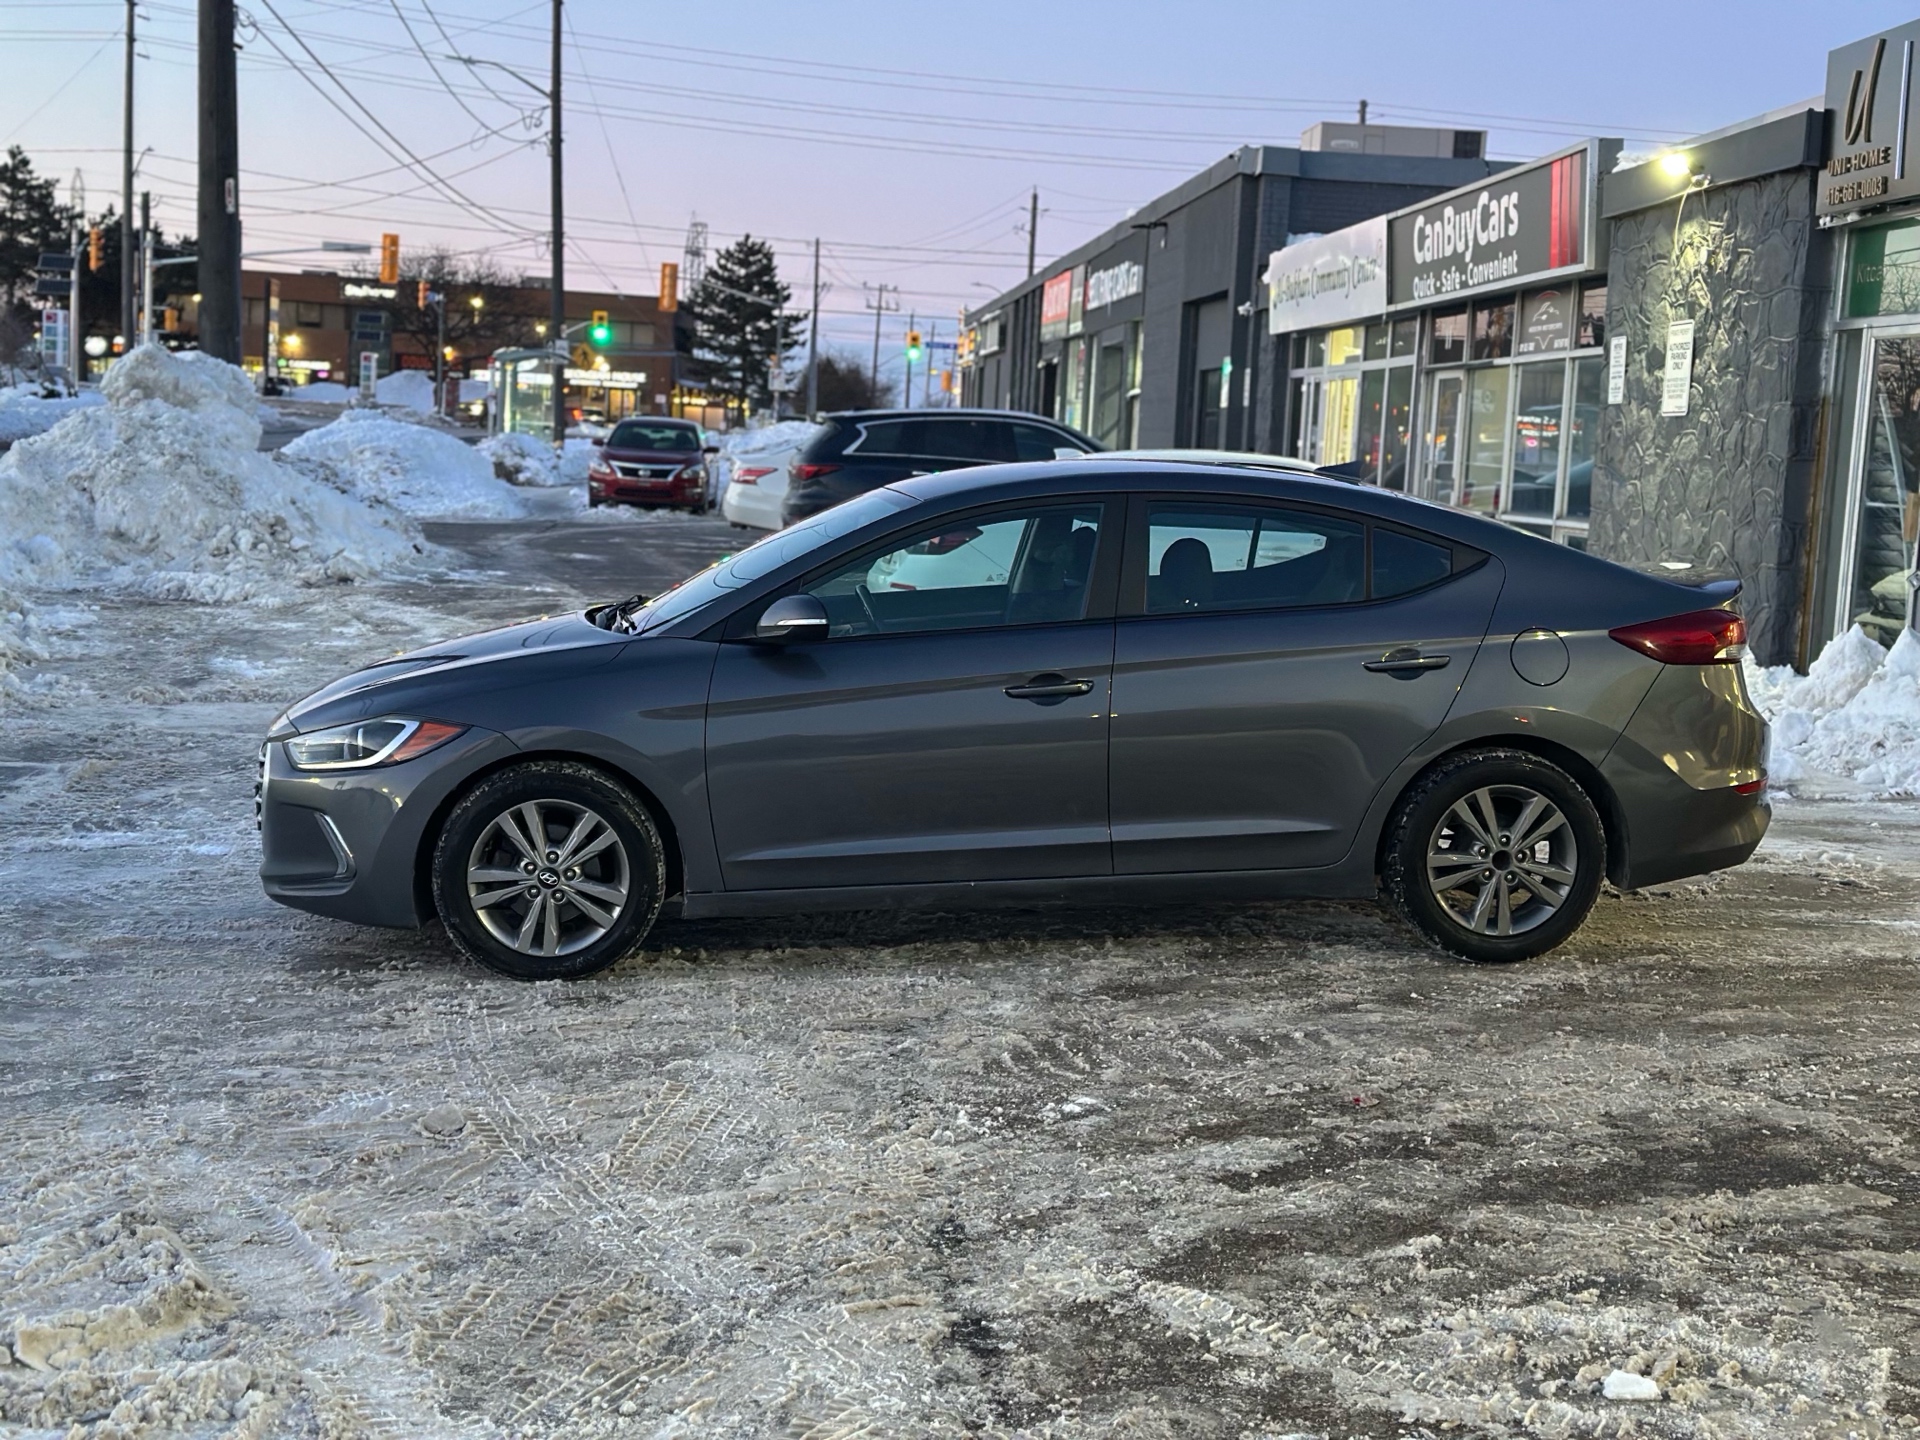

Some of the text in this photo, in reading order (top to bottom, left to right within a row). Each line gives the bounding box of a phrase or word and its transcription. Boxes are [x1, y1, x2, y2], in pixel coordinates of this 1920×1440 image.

[1827, 147, 1887, 176] UNI-HOME
[1413, 191, 1518, 264] CanBuyCars
[1413, 272, 1435, 300] Quick
[1441, 266, 1460, 292] Safe
[1467, 250, 1518, 286] Convenient
